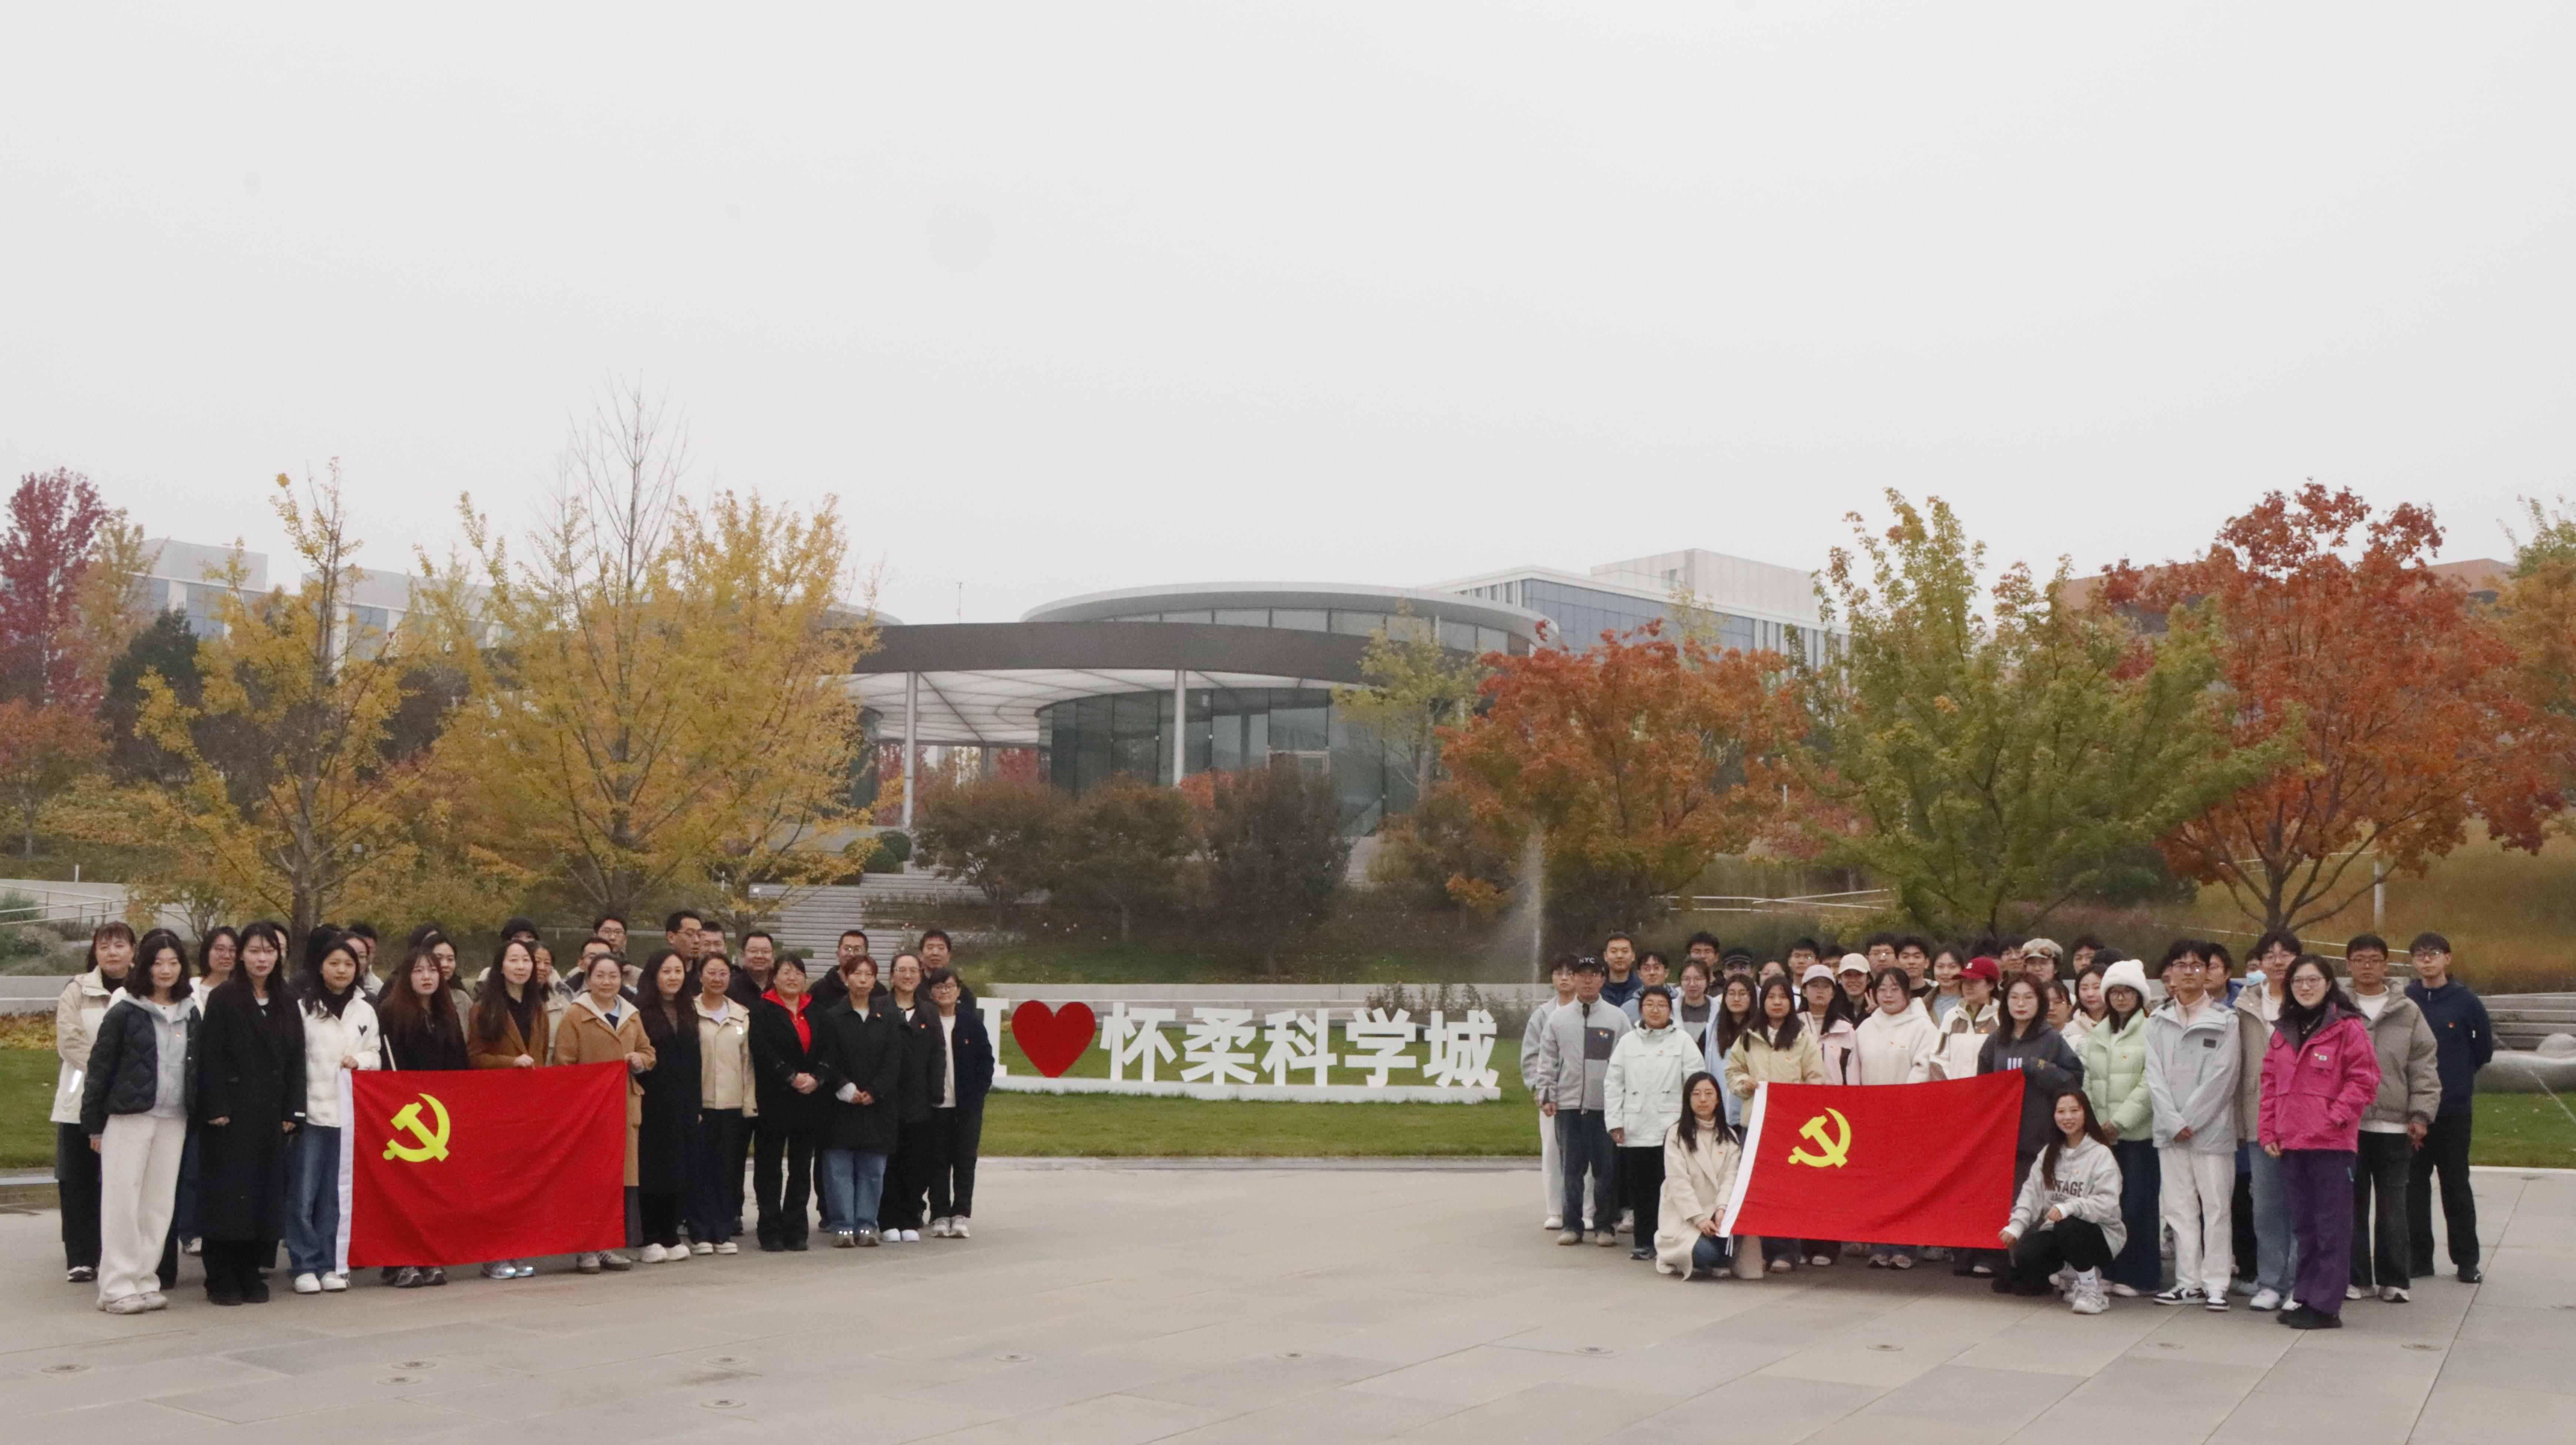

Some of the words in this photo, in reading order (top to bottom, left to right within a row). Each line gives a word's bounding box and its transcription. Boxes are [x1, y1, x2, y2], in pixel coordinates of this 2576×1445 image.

[976, 997, 1009, 1078] I
[1099, 1002, 1499, 1089] 怀柔科学城
